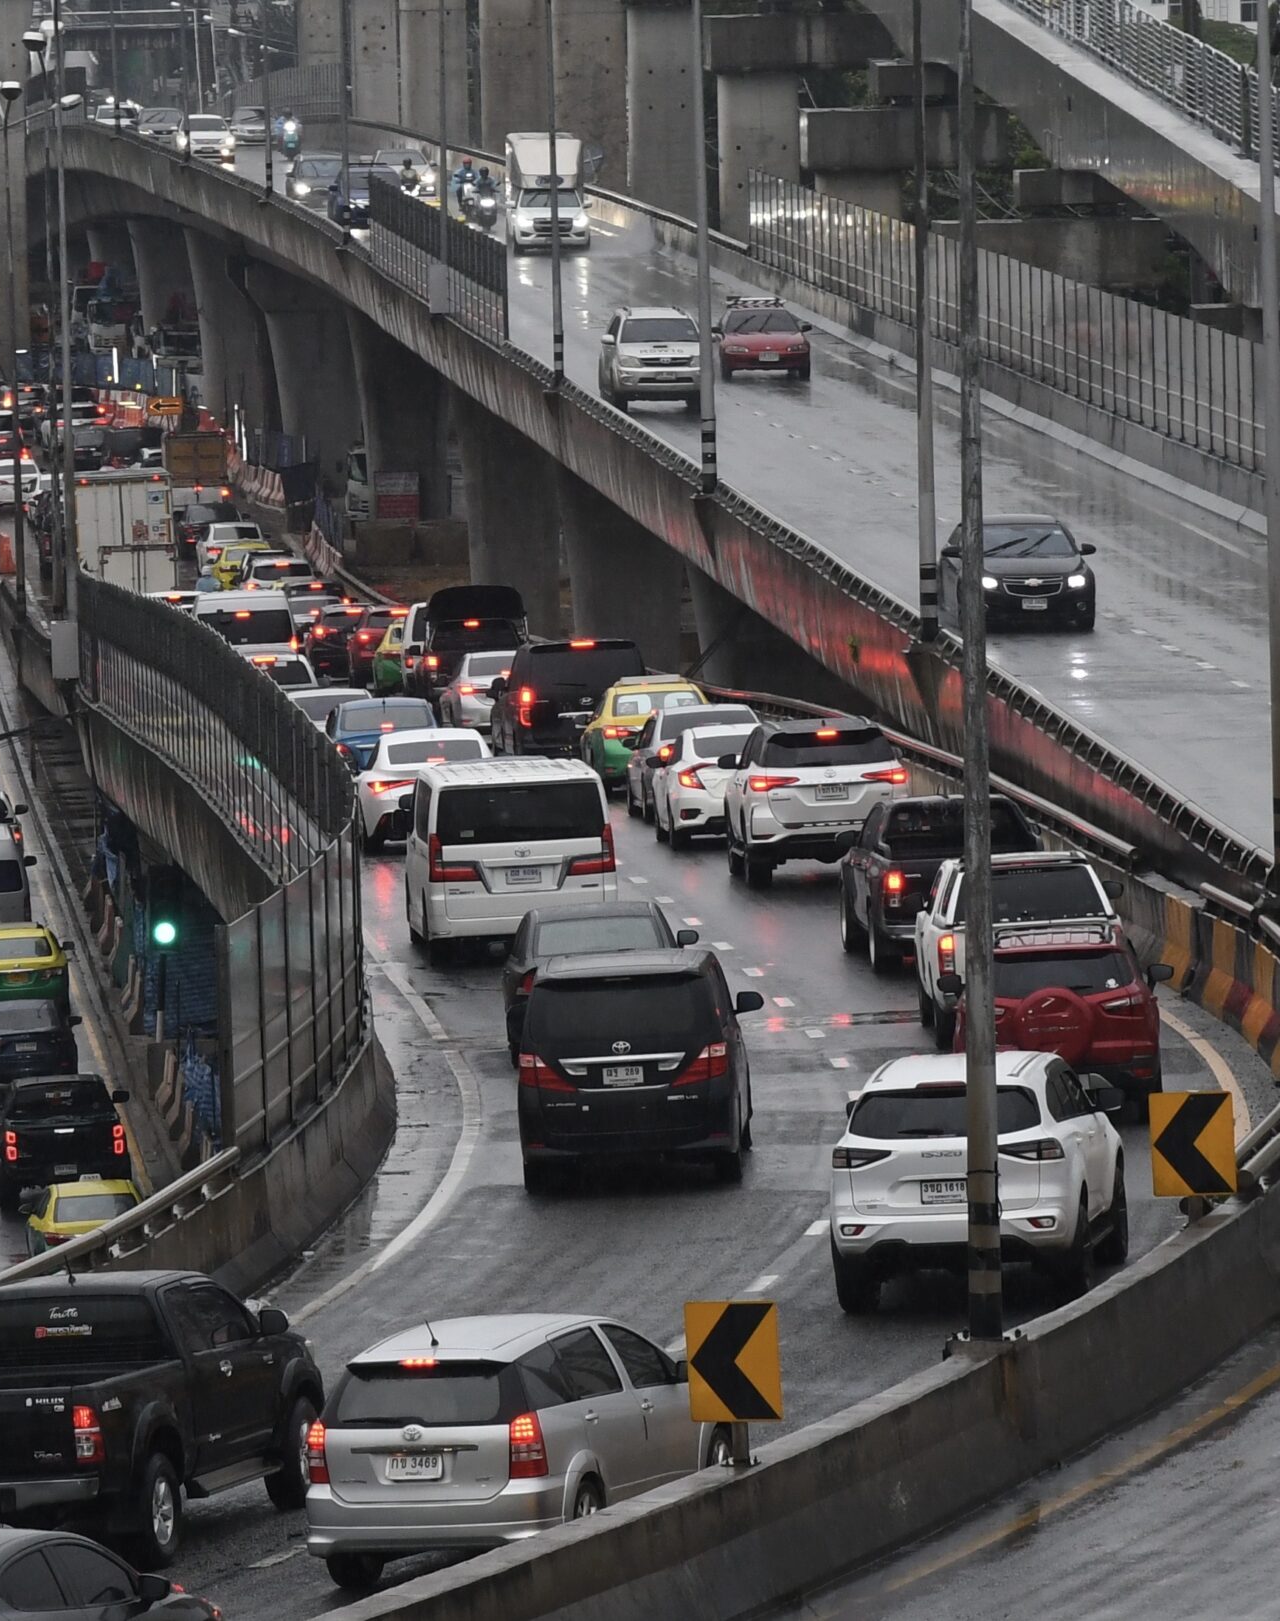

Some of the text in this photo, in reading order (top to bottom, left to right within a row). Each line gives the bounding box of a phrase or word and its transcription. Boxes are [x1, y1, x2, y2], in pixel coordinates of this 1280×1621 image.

[945, 1182, 965, 1192] 1618
[35, 1397, 65, 1405] HILUX
[410, 1457, 438, 1469] 3469
